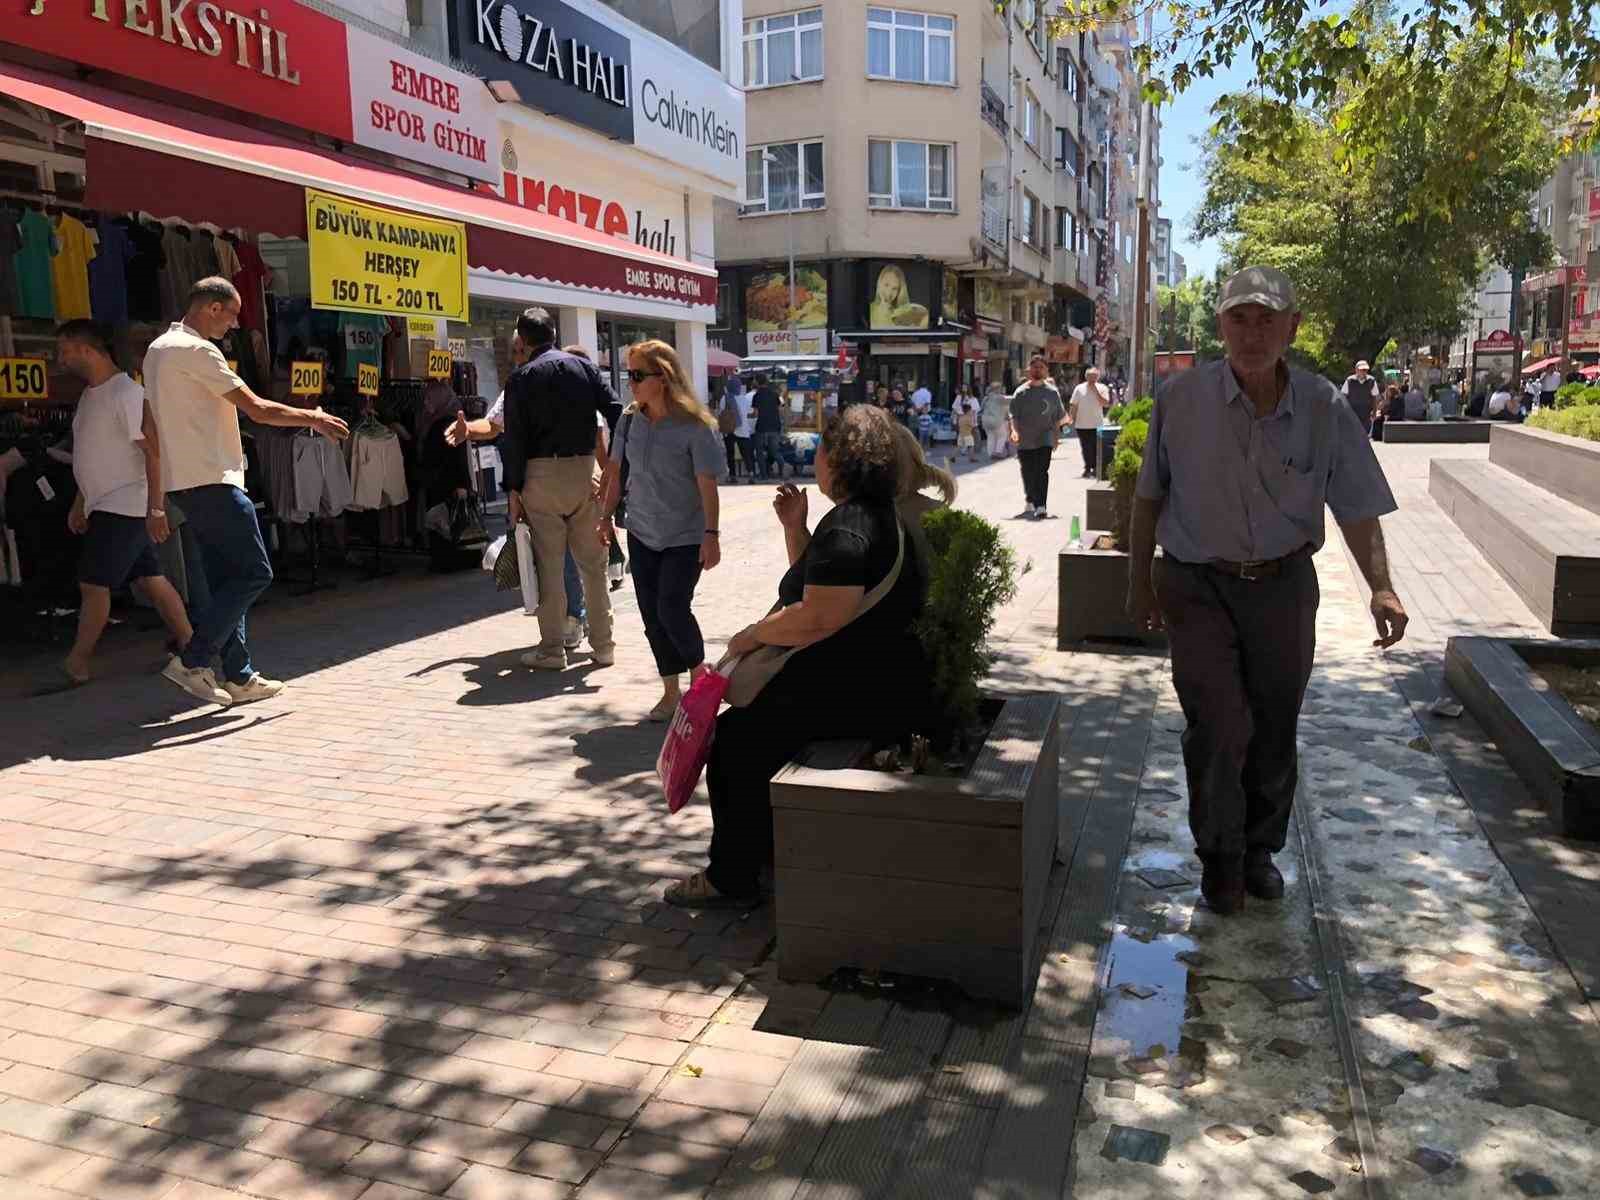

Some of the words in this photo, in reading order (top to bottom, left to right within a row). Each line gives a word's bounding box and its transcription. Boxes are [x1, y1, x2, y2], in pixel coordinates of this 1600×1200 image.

[389, 60, 460, 114] EMRE
[571, 38, 629, 107] HALI
[370, 100, 426, 143] SPOR
[434, 119, 487, 163] GİYİM
[641, 78, 700, 143] Calvin
[702, 106, 738, 159] Klein
[315, 203, 373, 241] BÜYÜK
[376, 221, 457, 255] KAMPANYA
[364, 250, 420, 282] HERŞEY
[625, 267, 652, 288] EMRE
[653, 271, 676, 292] SPOR
[678, 274, 701, 297] GİYİM
[331, 279, 359, 302] 150
[364, 282, 382, 305] TL
[396, 287, 423, 309] 200
[426, 291, 444, 311] TL
[350, 330, 374, 346] 150
[449, 340, 465, 359] 250
[0, 362, 45, 395] 150
[293, 368, 320, 388] 200
[429, 354, 450, 373] 200
[359, 371, 378, 390] 200
